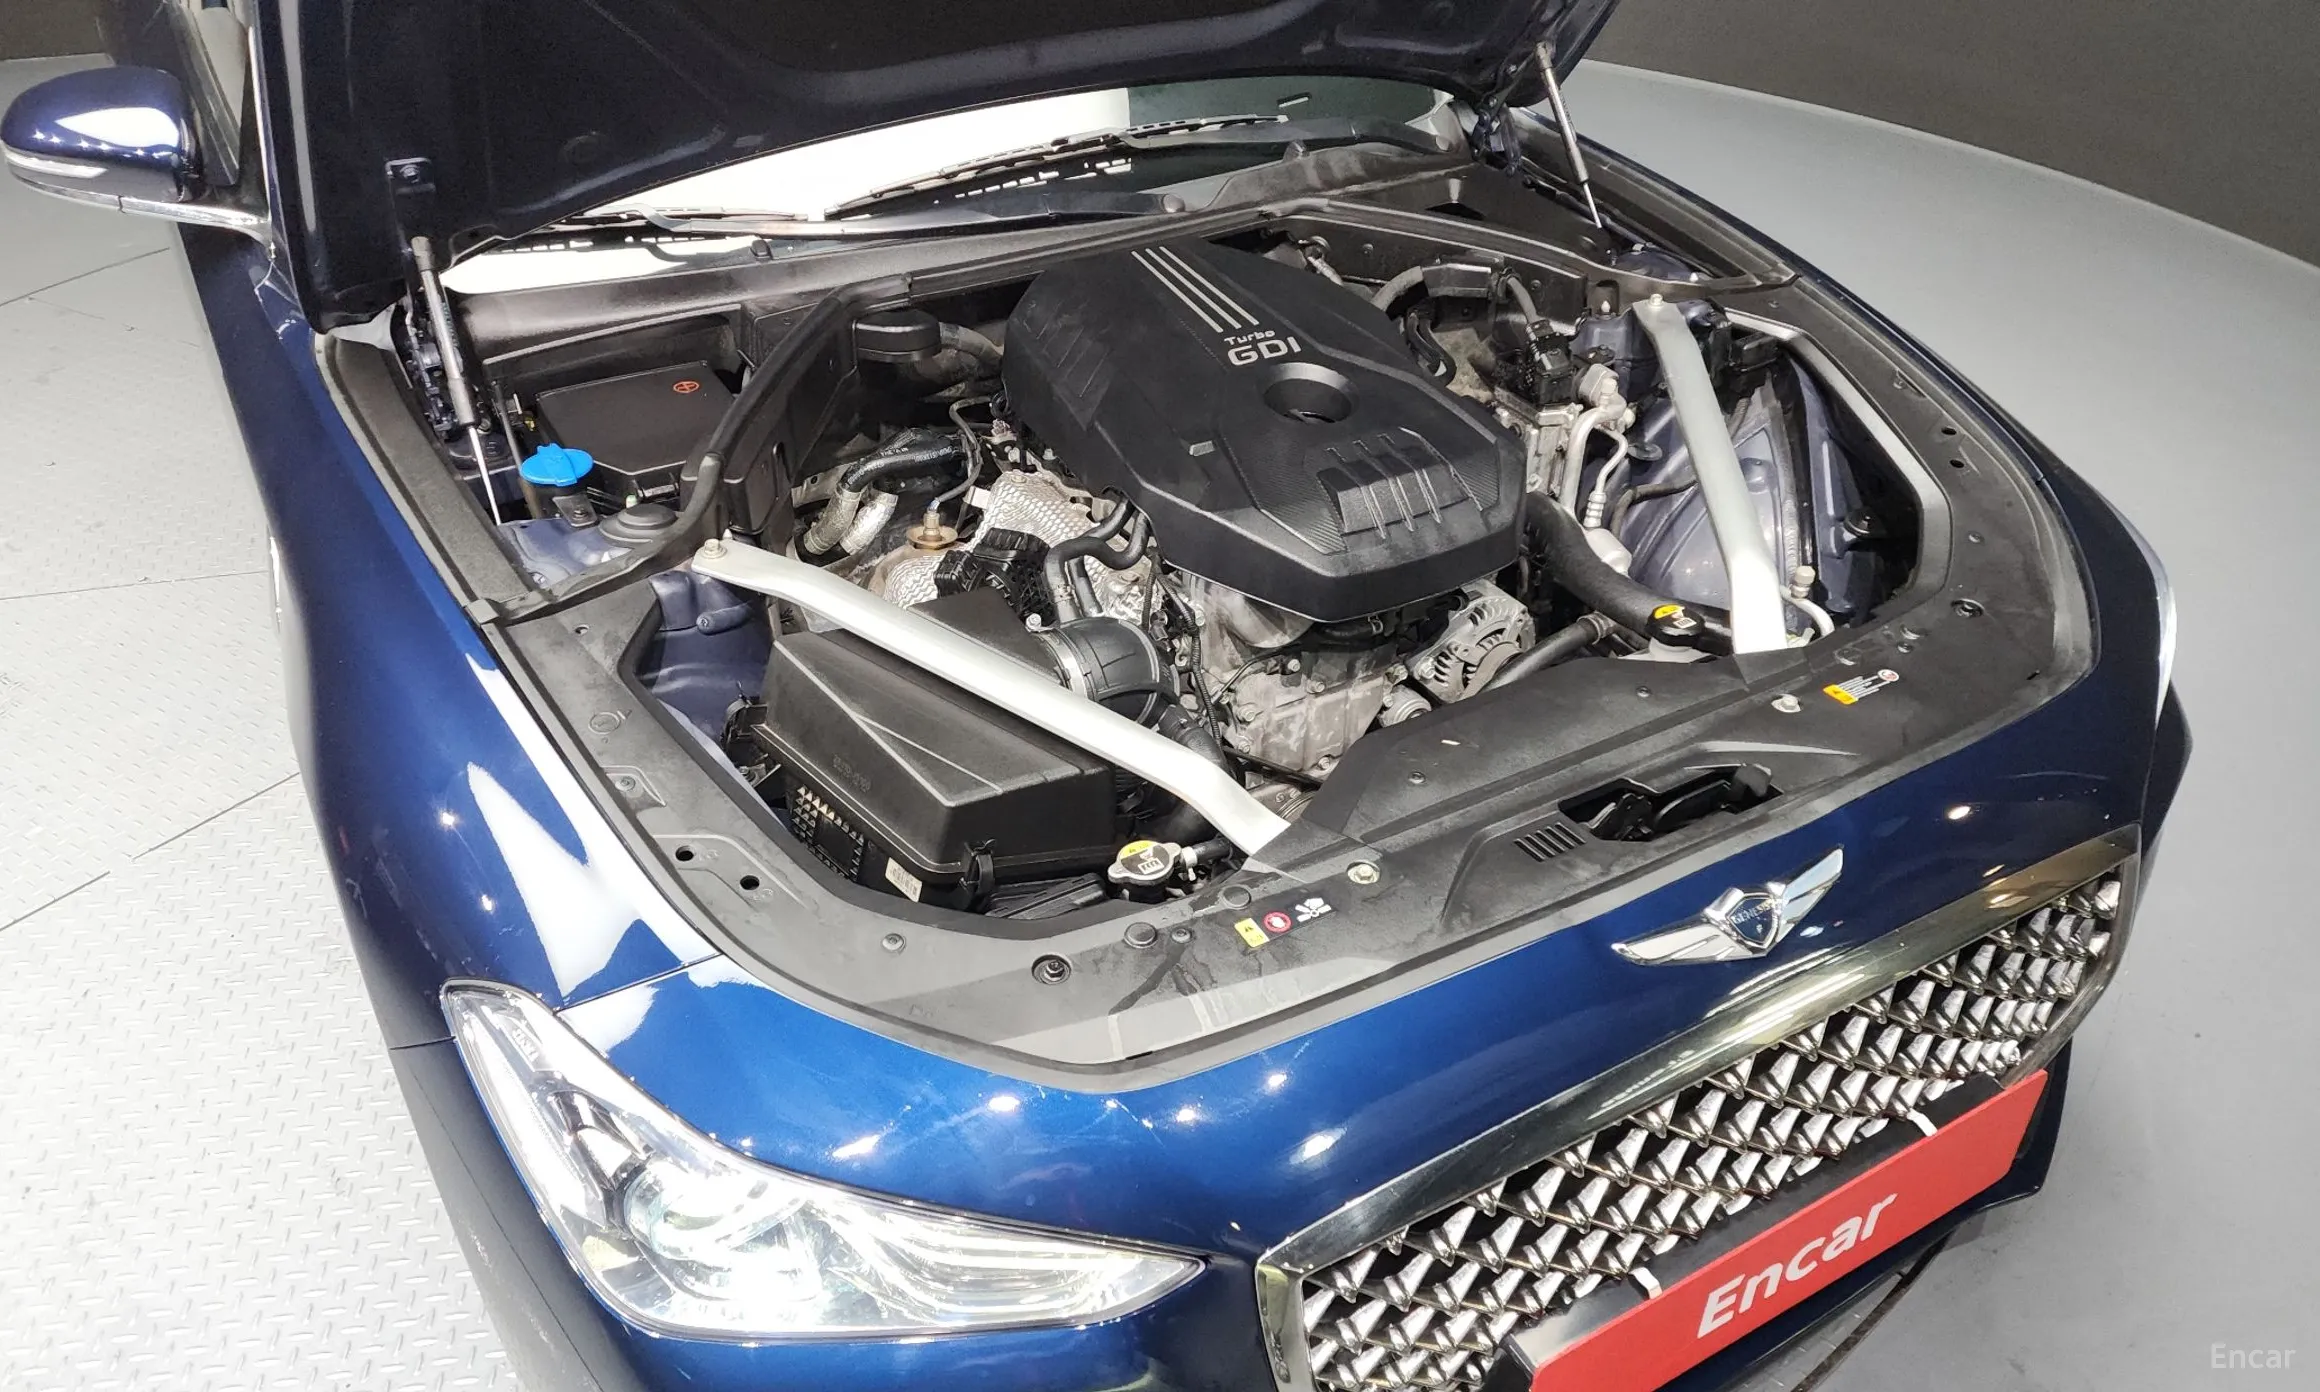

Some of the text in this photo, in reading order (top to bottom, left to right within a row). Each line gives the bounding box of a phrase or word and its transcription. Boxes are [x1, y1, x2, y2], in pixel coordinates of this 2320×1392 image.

[1224, 330, 1275, 346] Turbo
[1227, 336, 1302, 366] GDI
[1731, 898, 1775, 924] GENESIS
[1697, 1193, 1898, 1339] Encar
